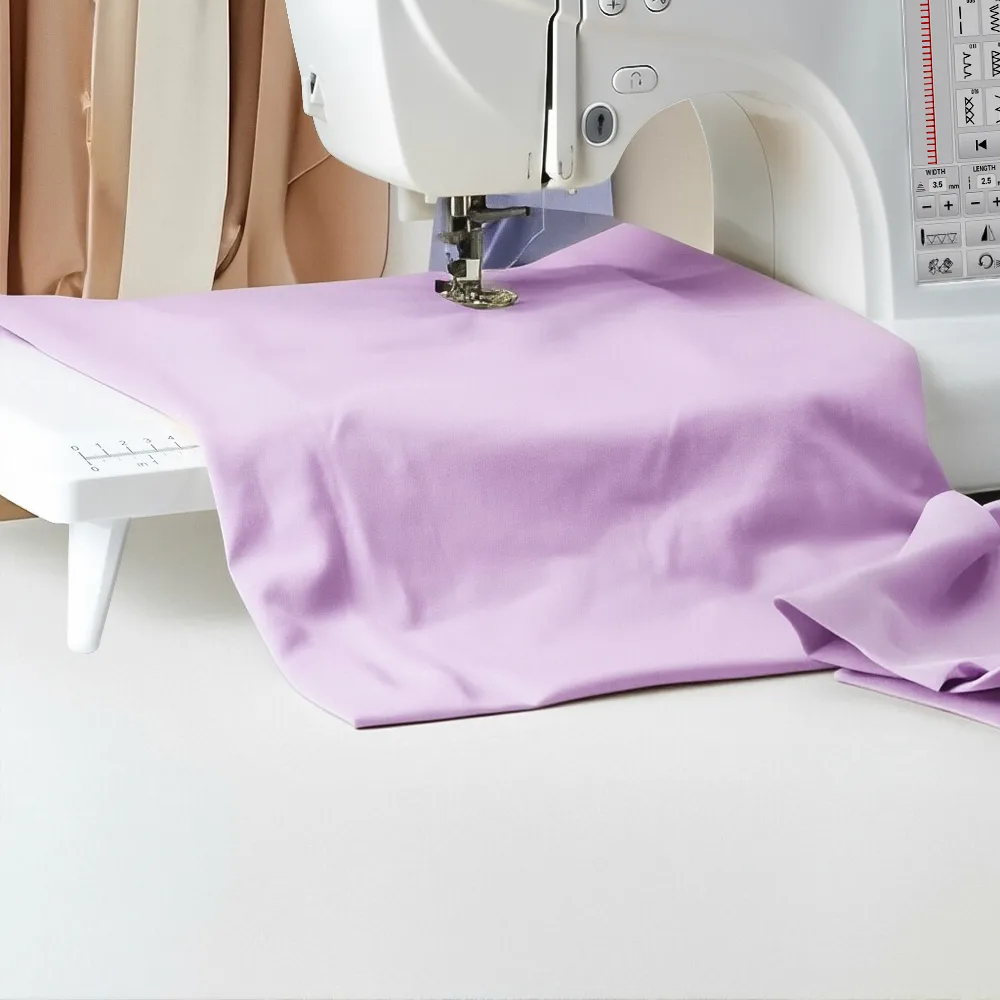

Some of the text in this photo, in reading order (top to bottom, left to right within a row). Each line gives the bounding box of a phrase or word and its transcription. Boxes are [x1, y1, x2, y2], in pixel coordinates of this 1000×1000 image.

[925, 168, 946, 176] WIDTH
[972, 164, 996, 173] LENGTH
[932, 181, 943, 189] 3.5
[981, 177, 992, 185] 2.5
